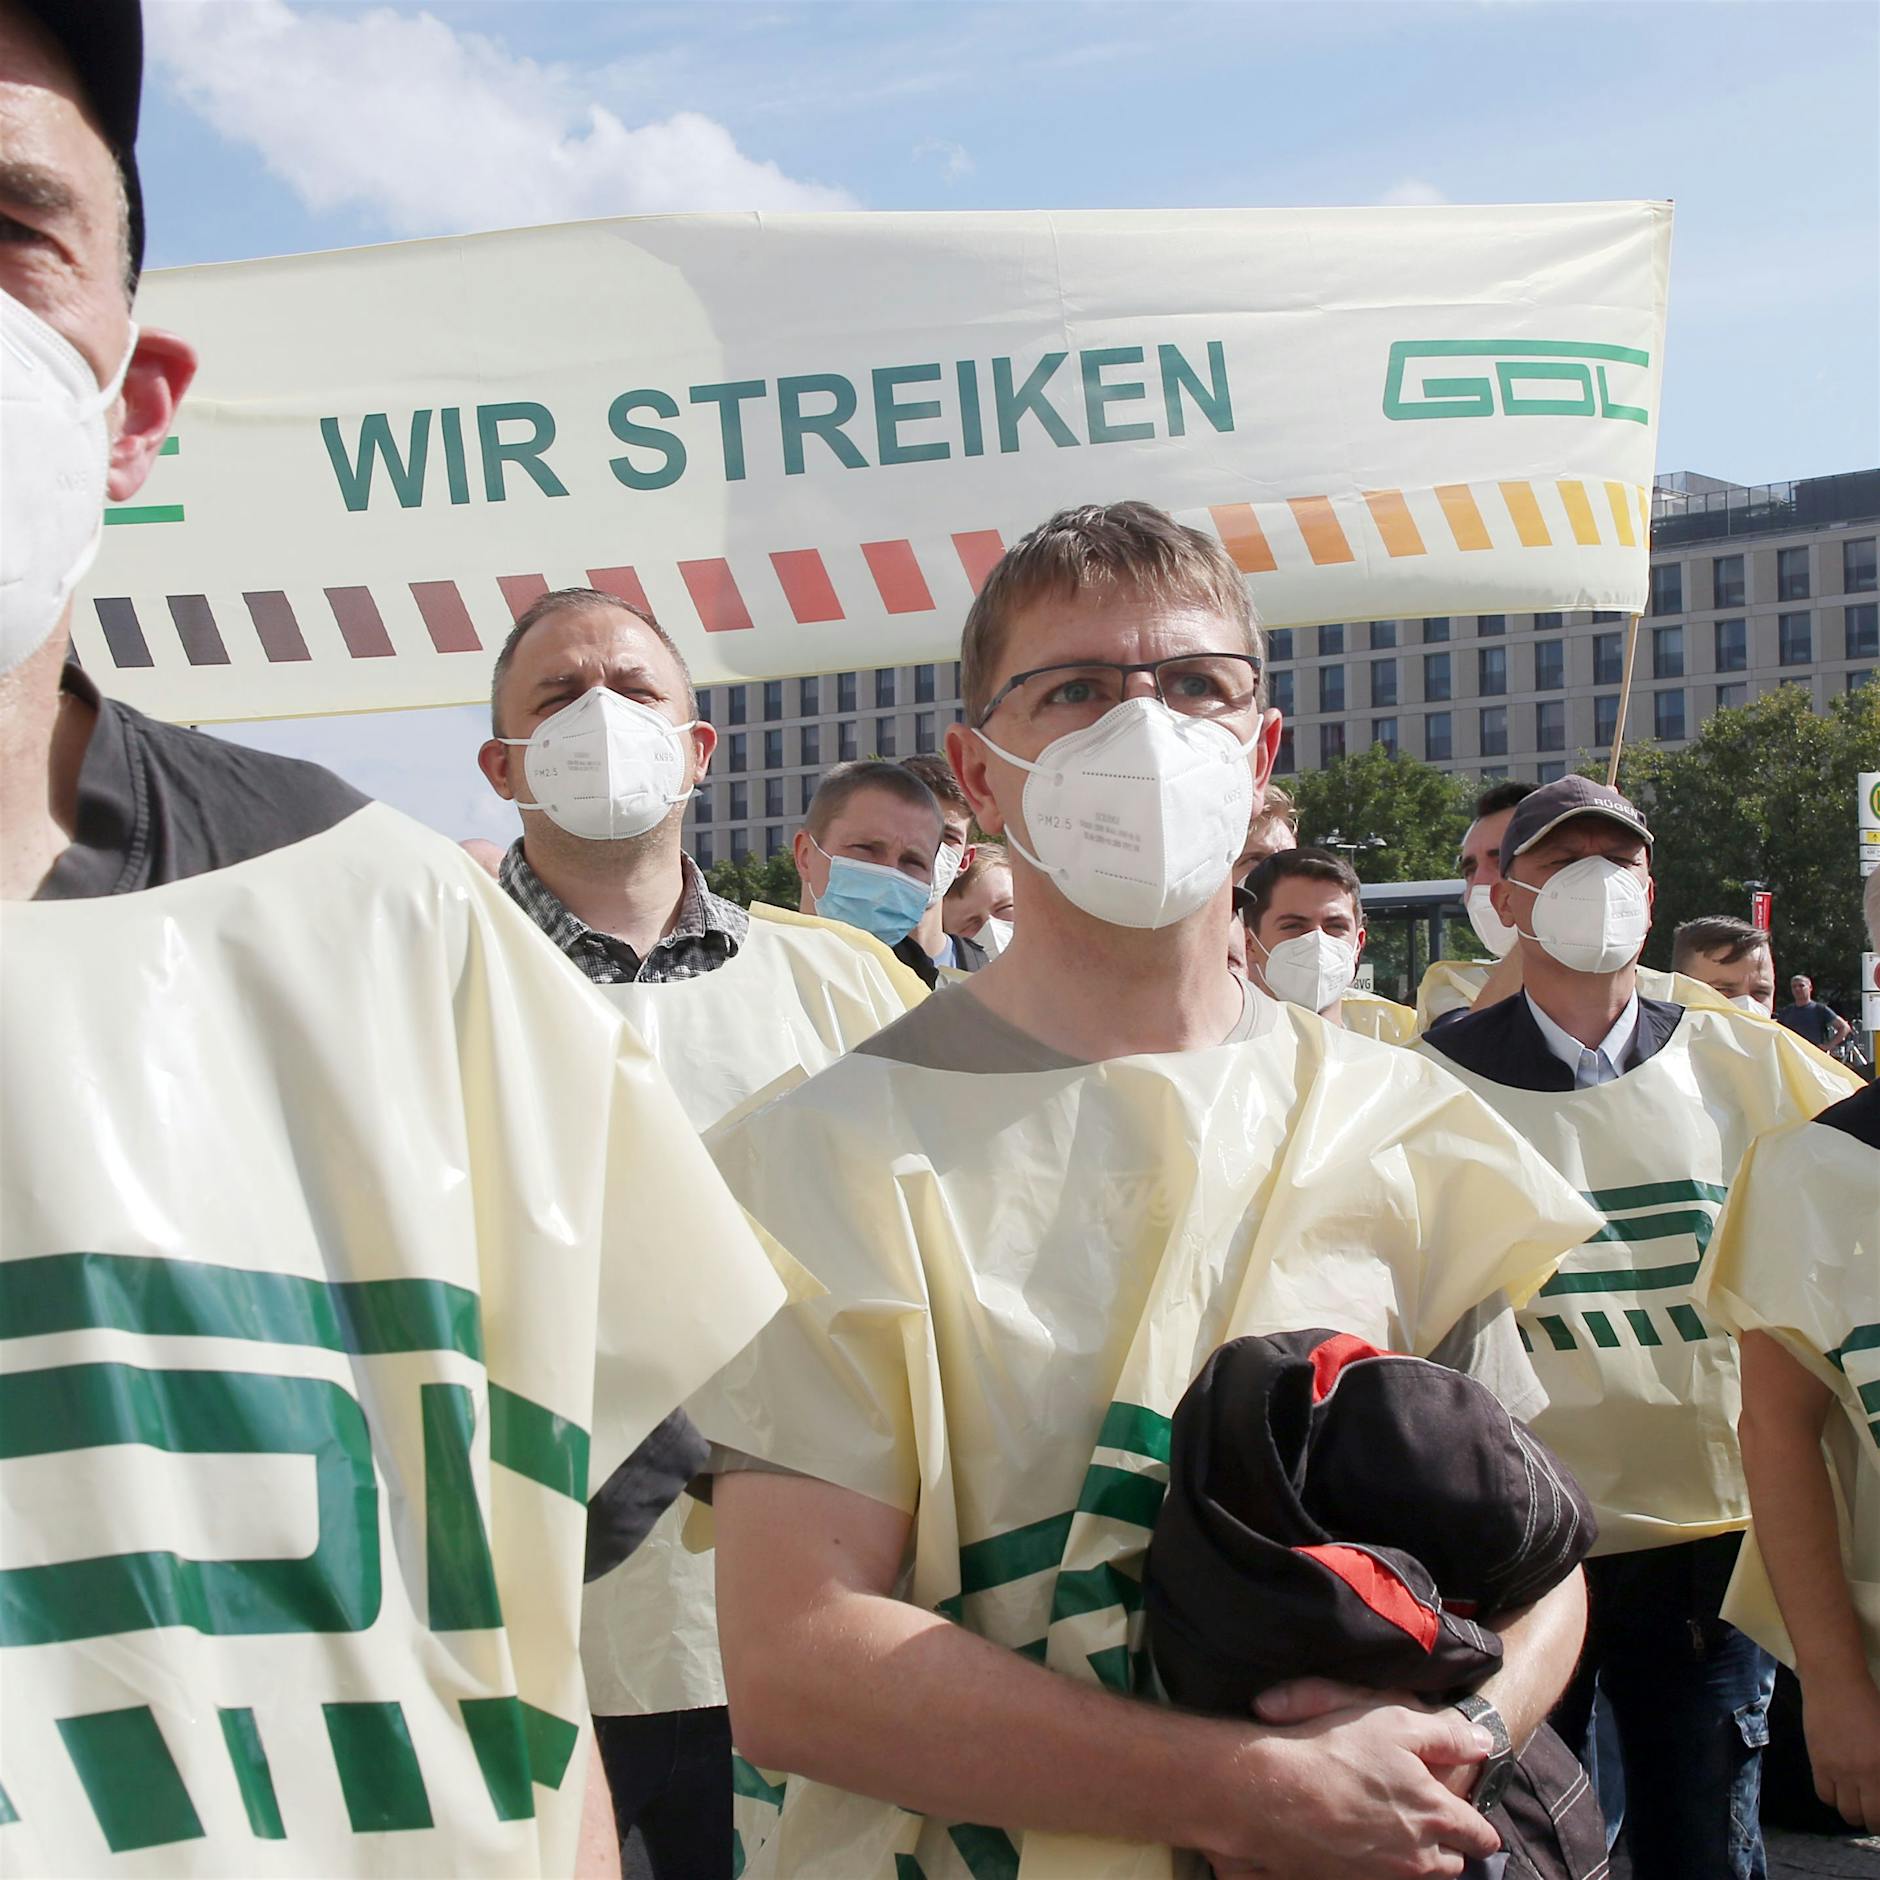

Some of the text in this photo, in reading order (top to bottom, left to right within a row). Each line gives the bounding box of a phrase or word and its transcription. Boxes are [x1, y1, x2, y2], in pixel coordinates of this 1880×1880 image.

[1382, 339, 1650, 425] GDL
[321, 403, 570, 511] WIR
[608, 341, 1234, 490] STREIKEN
[1593, 797, 1639, 821] RÜGEN
